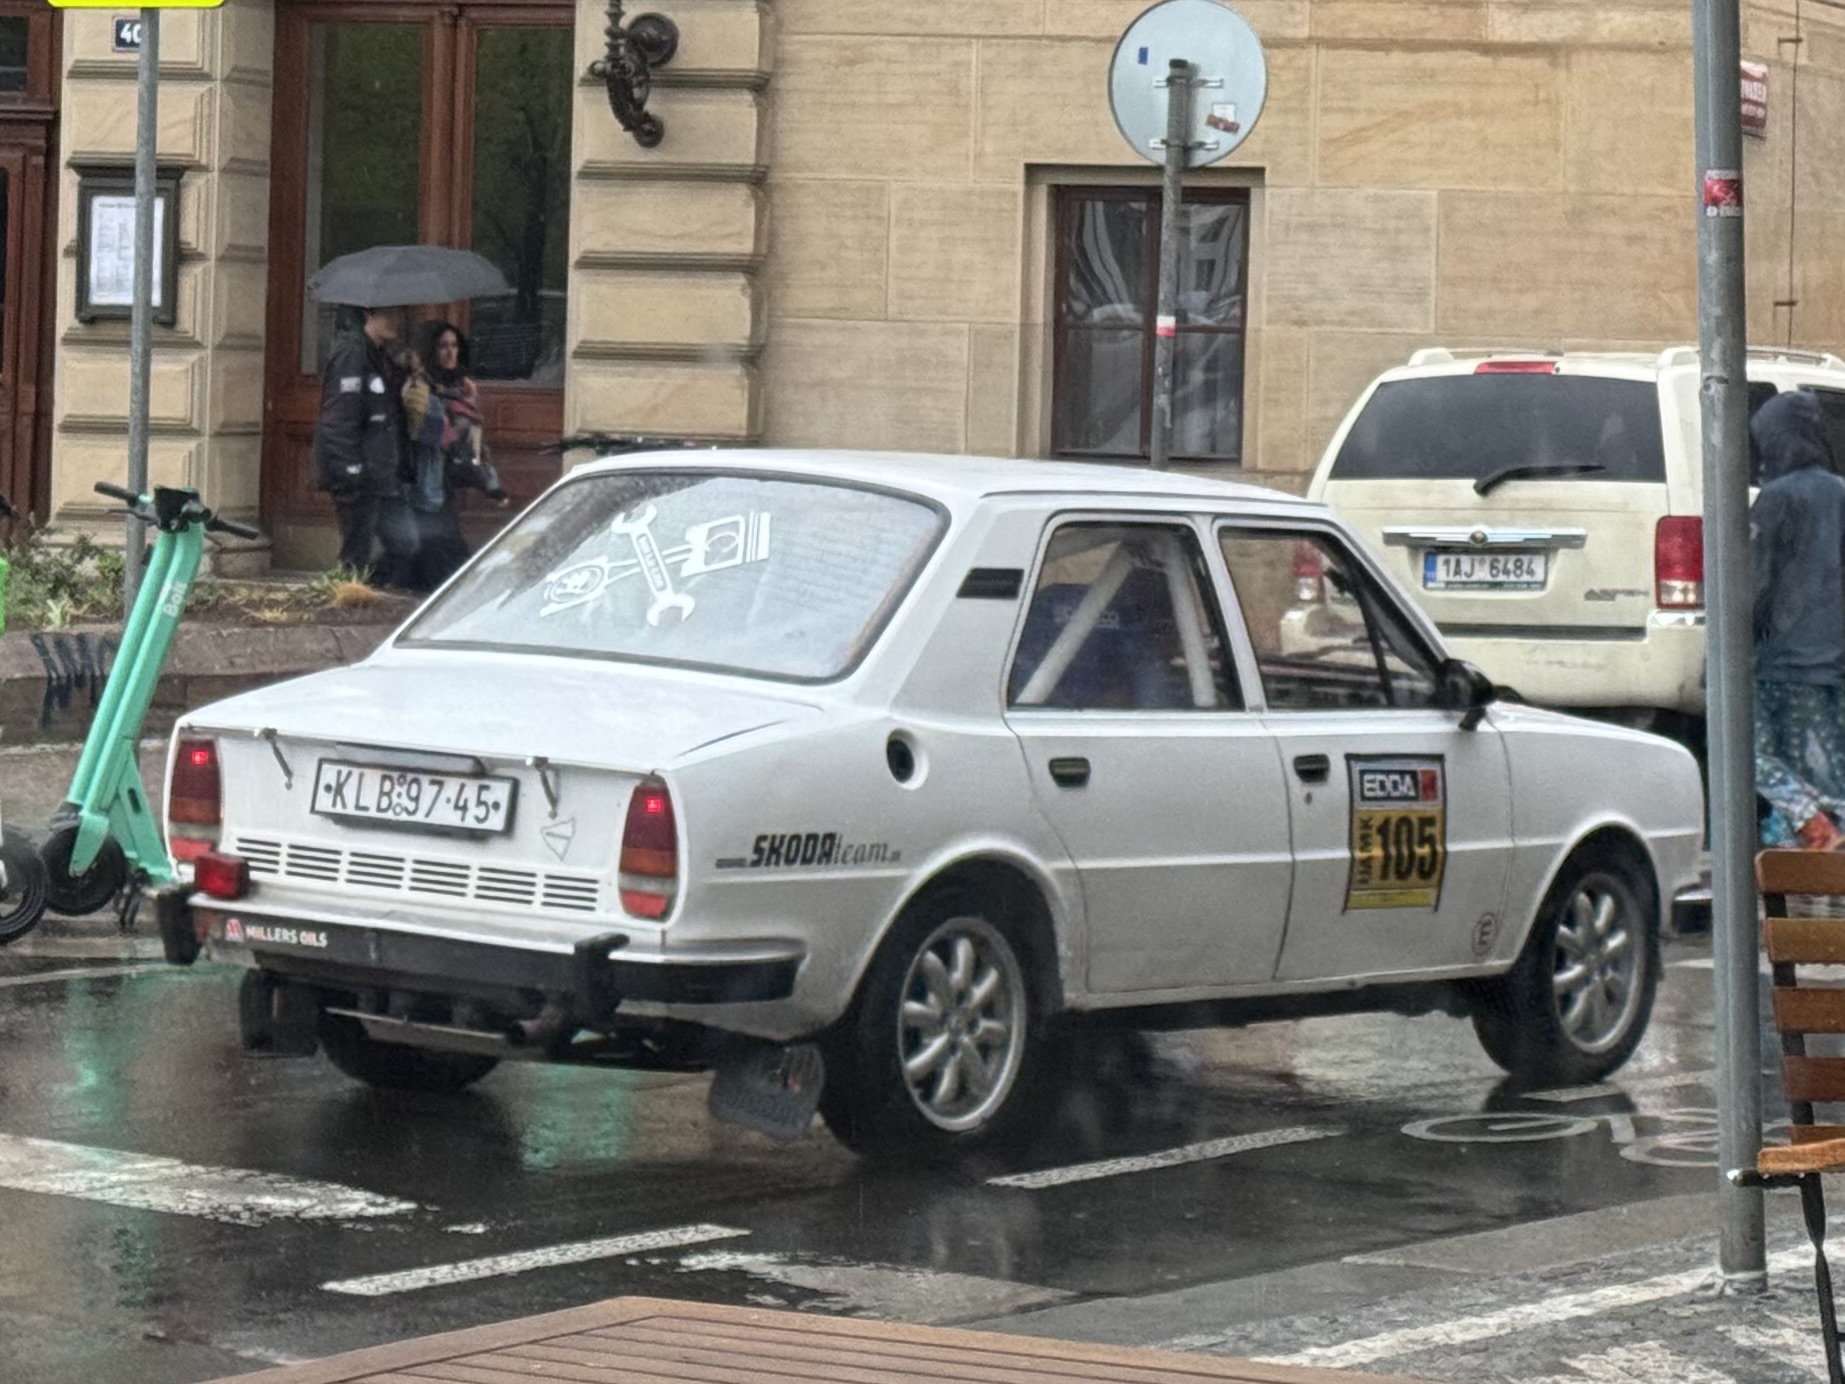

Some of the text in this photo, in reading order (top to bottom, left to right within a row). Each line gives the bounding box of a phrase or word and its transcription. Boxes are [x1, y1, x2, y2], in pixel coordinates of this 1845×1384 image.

[1442, 557, 1535, 579] 1AJ 6484
[331, 769, 395, 814] KLB
[1363, 774, 1416, 797] EDDA
[1375, 815, 1438, 881] 105
